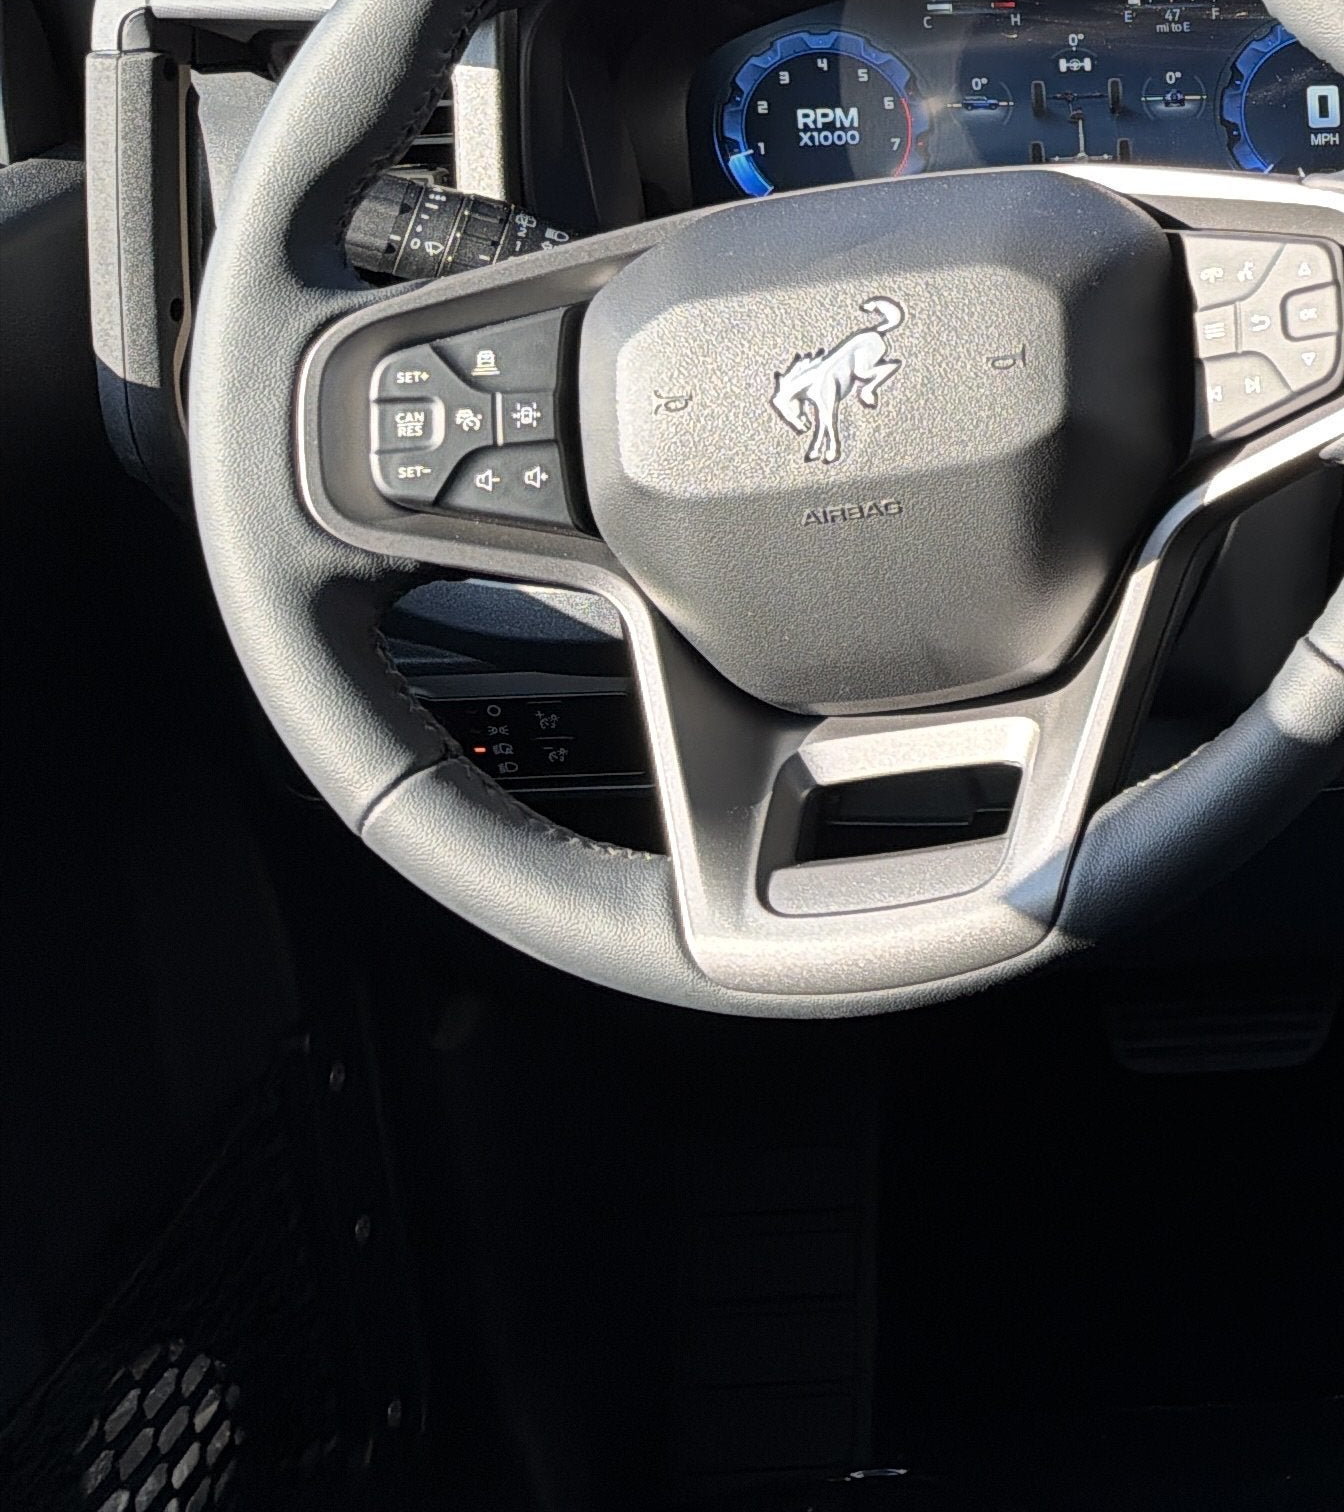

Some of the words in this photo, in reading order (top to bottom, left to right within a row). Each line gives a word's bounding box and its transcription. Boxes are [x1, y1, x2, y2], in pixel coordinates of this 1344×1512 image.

[922, 15, 933, 30] C
[1010, 13, 1021, 26] H
[1123, 9, 1133, 23] E
[1163, 8, 1181, 21] 47
[1211, 7, 1221, 20] F
[1155, 22, 1170, 33] mi
[1171, 22, 1182, 33] to
[1182, 21, 1191, 33] E
[816, 57, 829, 72] 4
[778, 71, 790, 85] 3
[857, 68, 869, 82] 5
[757, 99, 769, 114] 2
[883, 96, 895, 110] 6
[1306, 84, 1341, 129] 0
[796, 107, 859, 130] RPM
[890, 137, 901, 151] 7
[1310, 132, 1340, 146] MPH
[757, 141, 766, 155] 1
[394, 411, 425, 424] CAN
[397, 425, 424, 437] RES
[800, 497, 904, 528] AIRBAG
